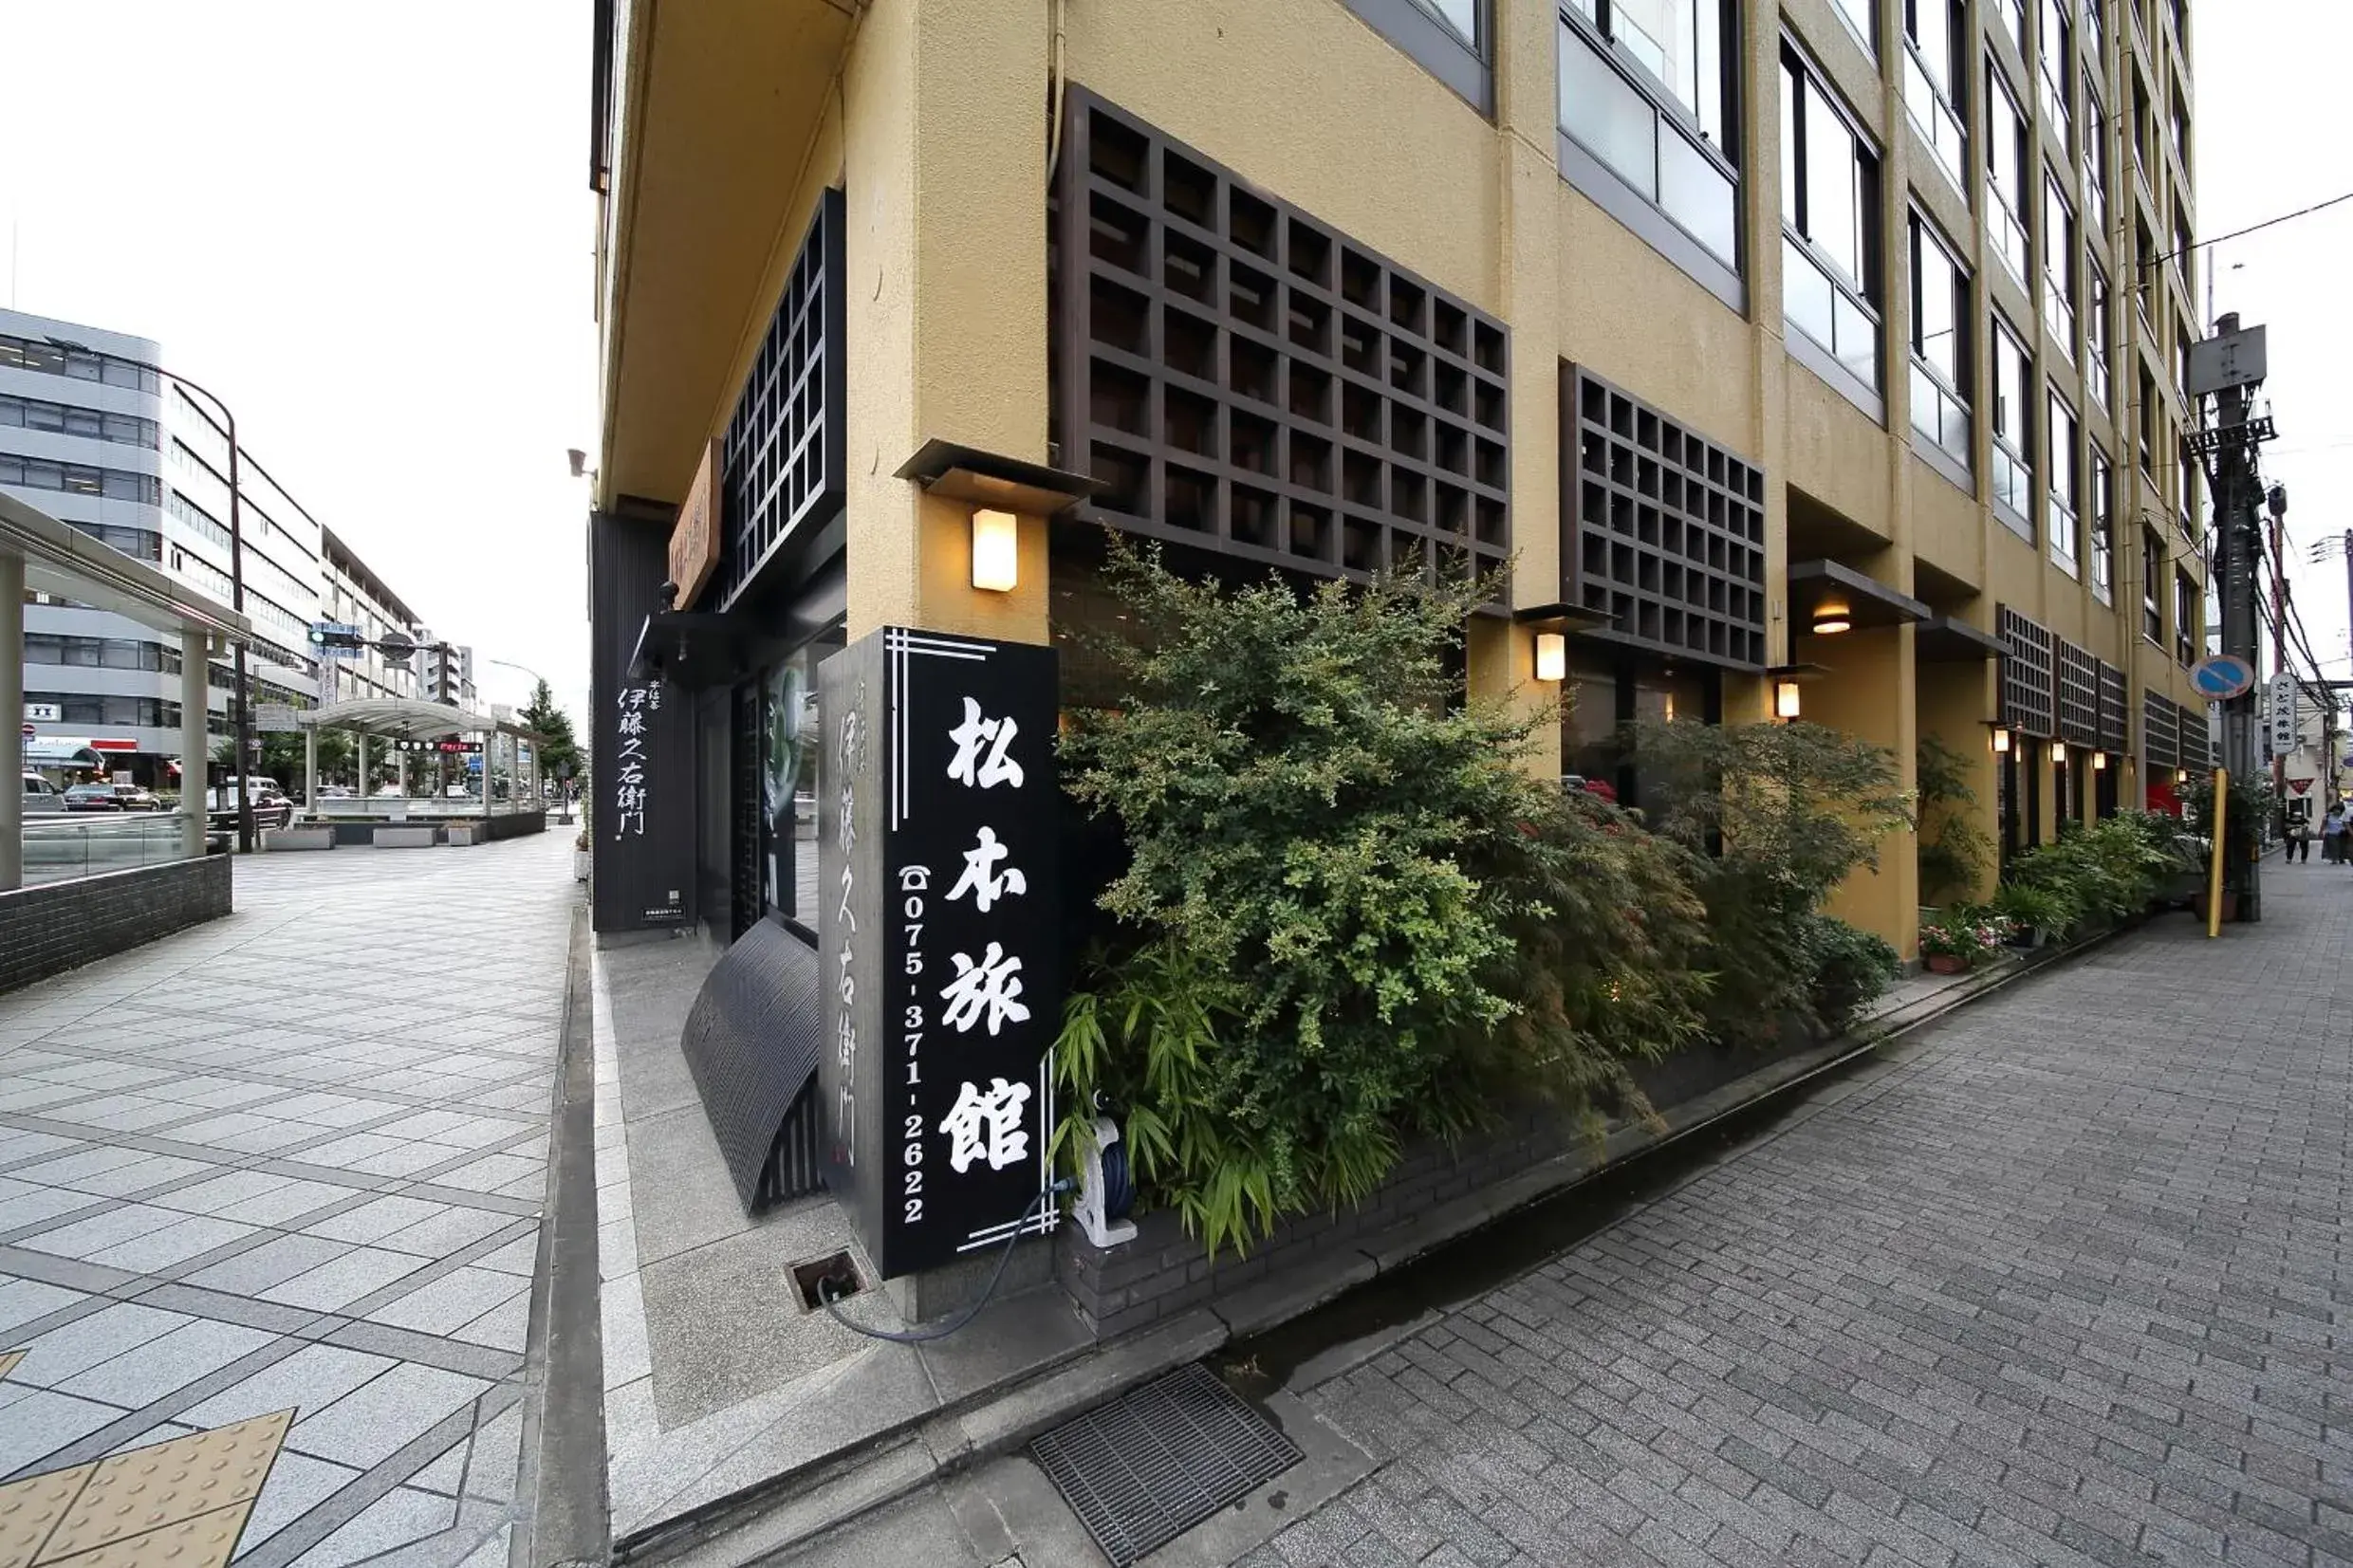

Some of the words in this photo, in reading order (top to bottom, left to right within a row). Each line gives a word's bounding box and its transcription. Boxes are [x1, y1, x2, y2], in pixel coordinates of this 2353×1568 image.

[617, 688, 647, 836] 伊藤久右衛門
[838, 710, 857, 1167] 伊藤久右衛門
[937, 695, 1032, 1174] 松本旅館
[904, 895, 925, 1225] 075-371-2622
